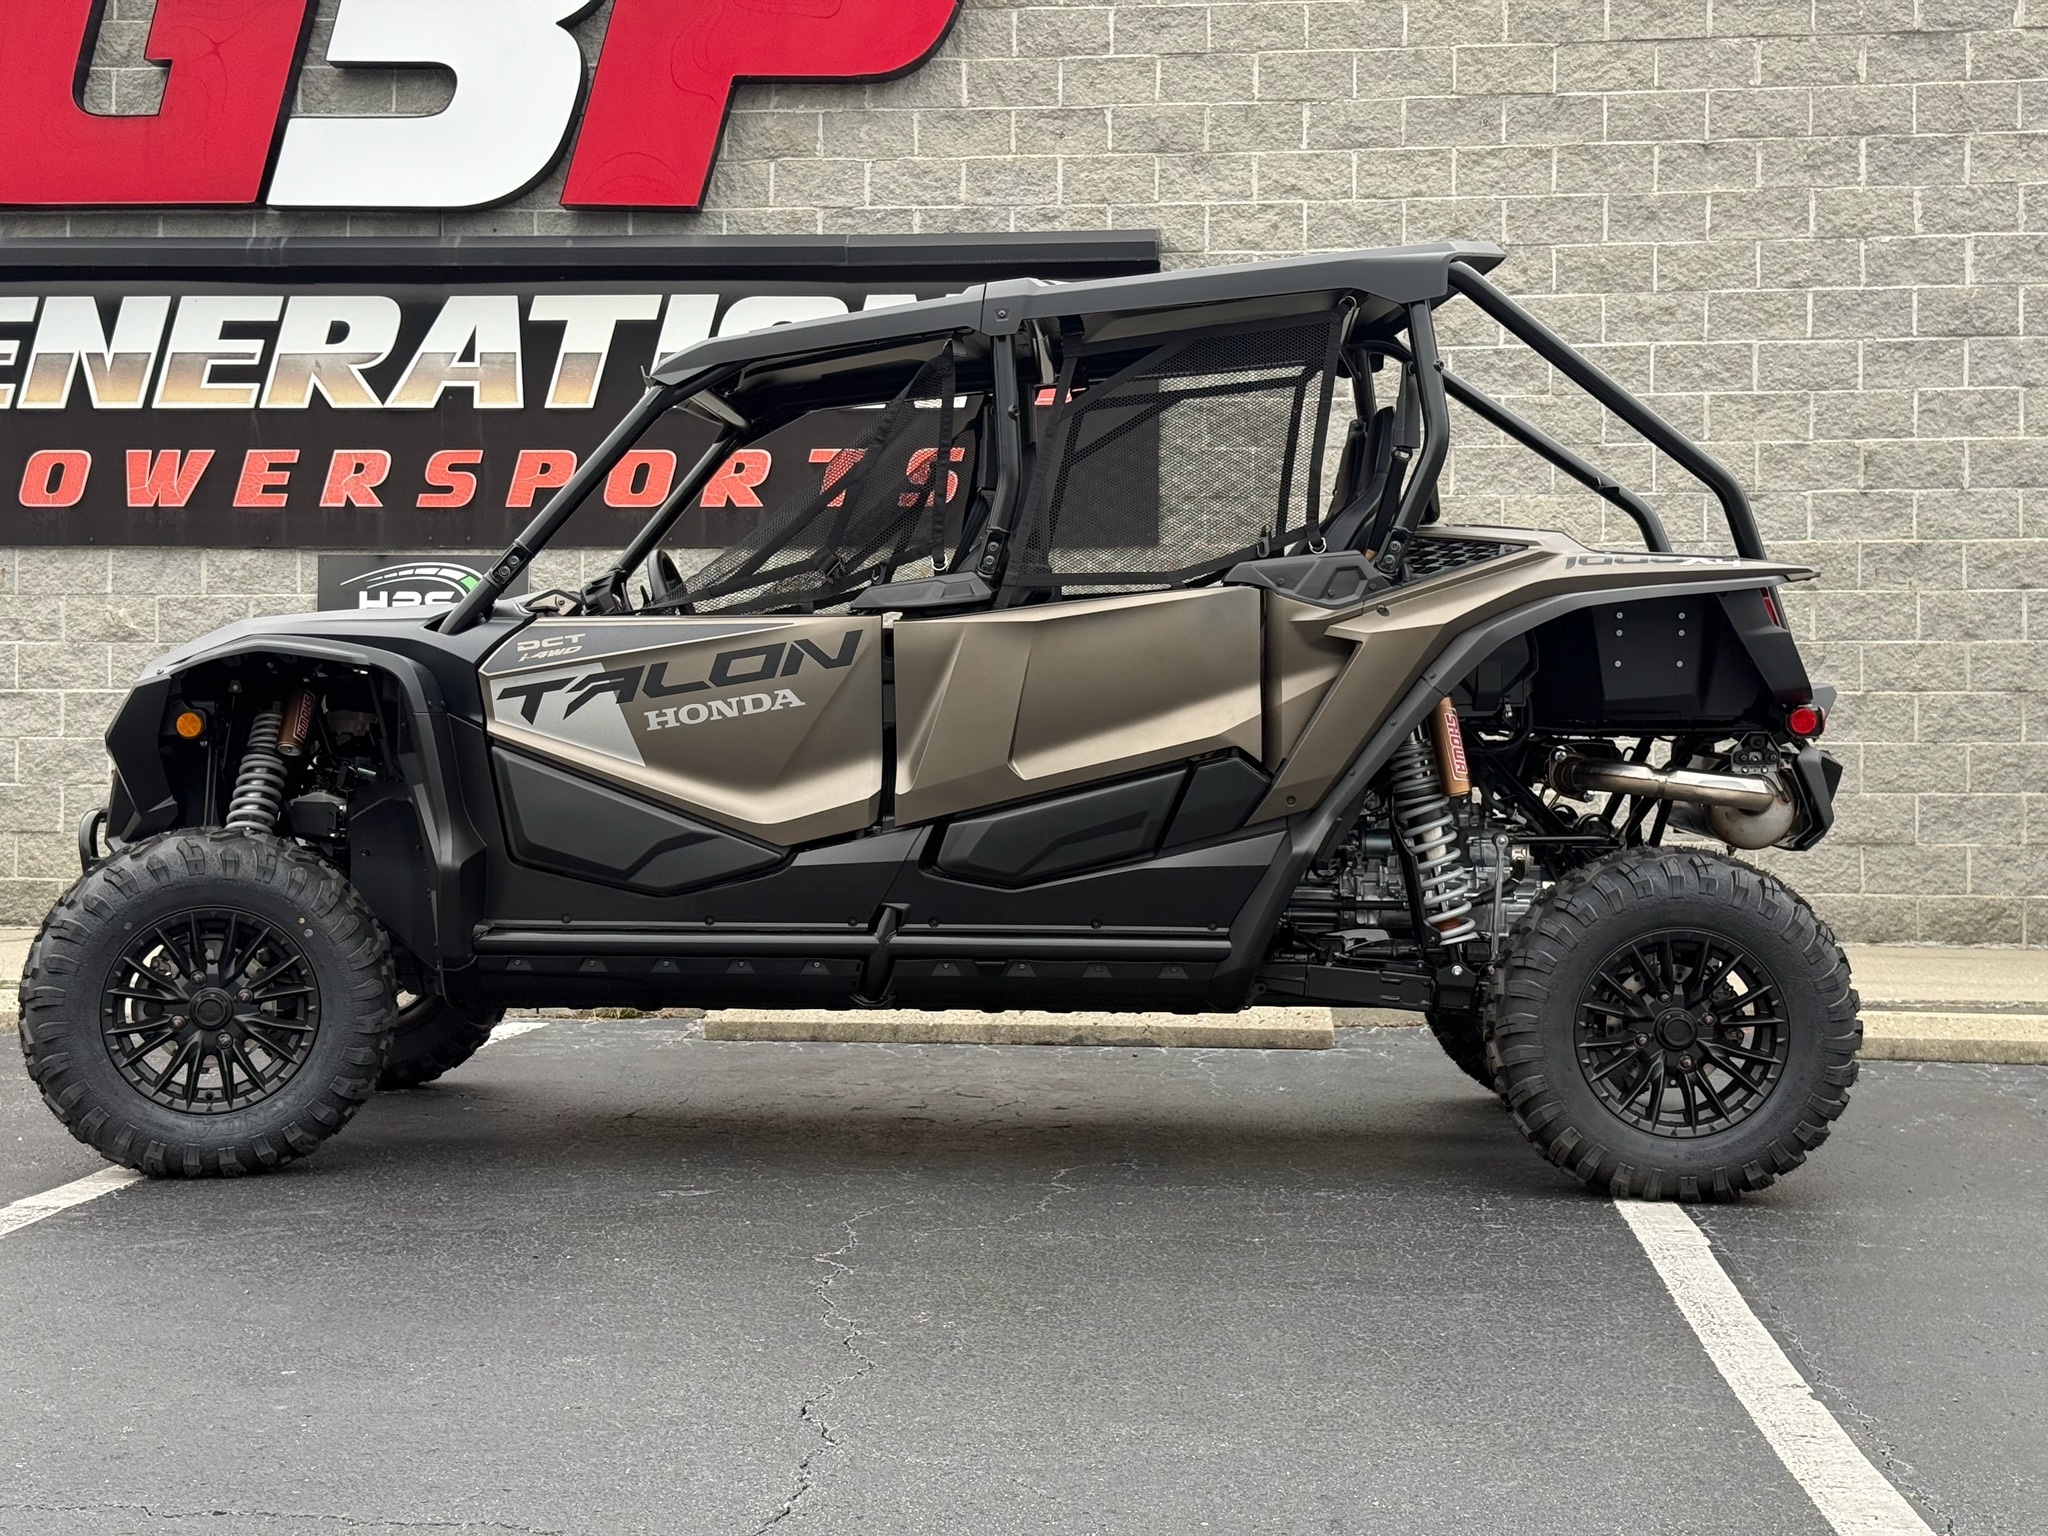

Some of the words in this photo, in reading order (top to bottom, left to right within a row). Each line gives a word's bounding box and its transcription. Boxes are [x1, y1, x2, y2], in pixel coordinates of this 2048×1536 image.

[517, 633, 586, 652] DCT
[496, 629, 863, 726] TALON
[296, 693, 314, 740] SHOWA
[643, 688, 805, 731] HONDA
[1445, 712, 1468, 774] SHOWA
[195, 1078, 312, 1138] KENDA
